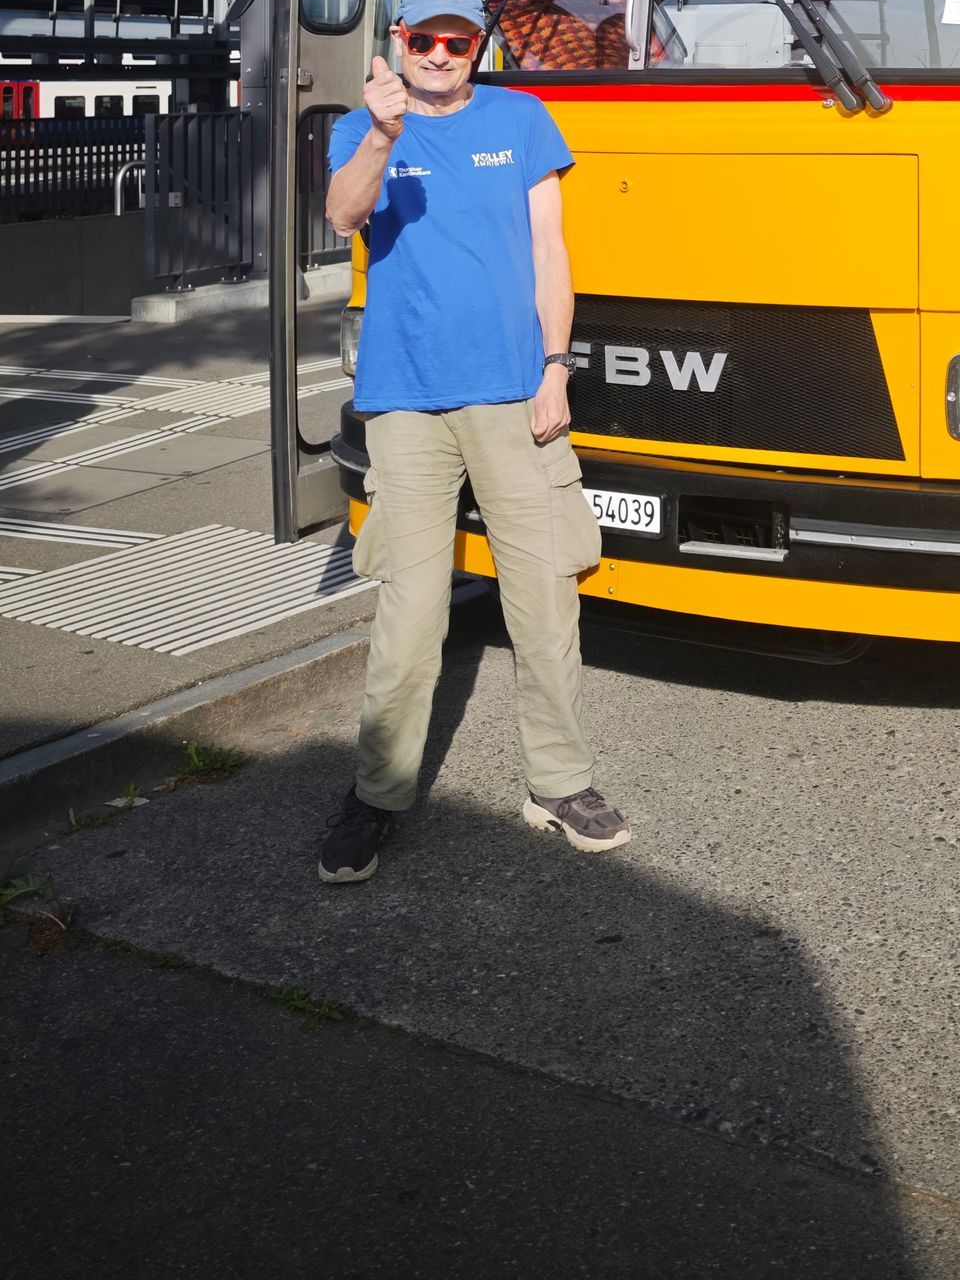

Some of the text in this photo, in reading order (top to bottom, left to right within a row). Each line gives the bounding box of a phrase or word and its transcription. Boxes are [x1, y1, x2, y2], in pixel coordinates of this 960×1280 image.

[472, 149, 513, 161] VOLLEY
[474, 158, 516, 167] AMRISWIL
[593, 494, 655, 528] 54039
